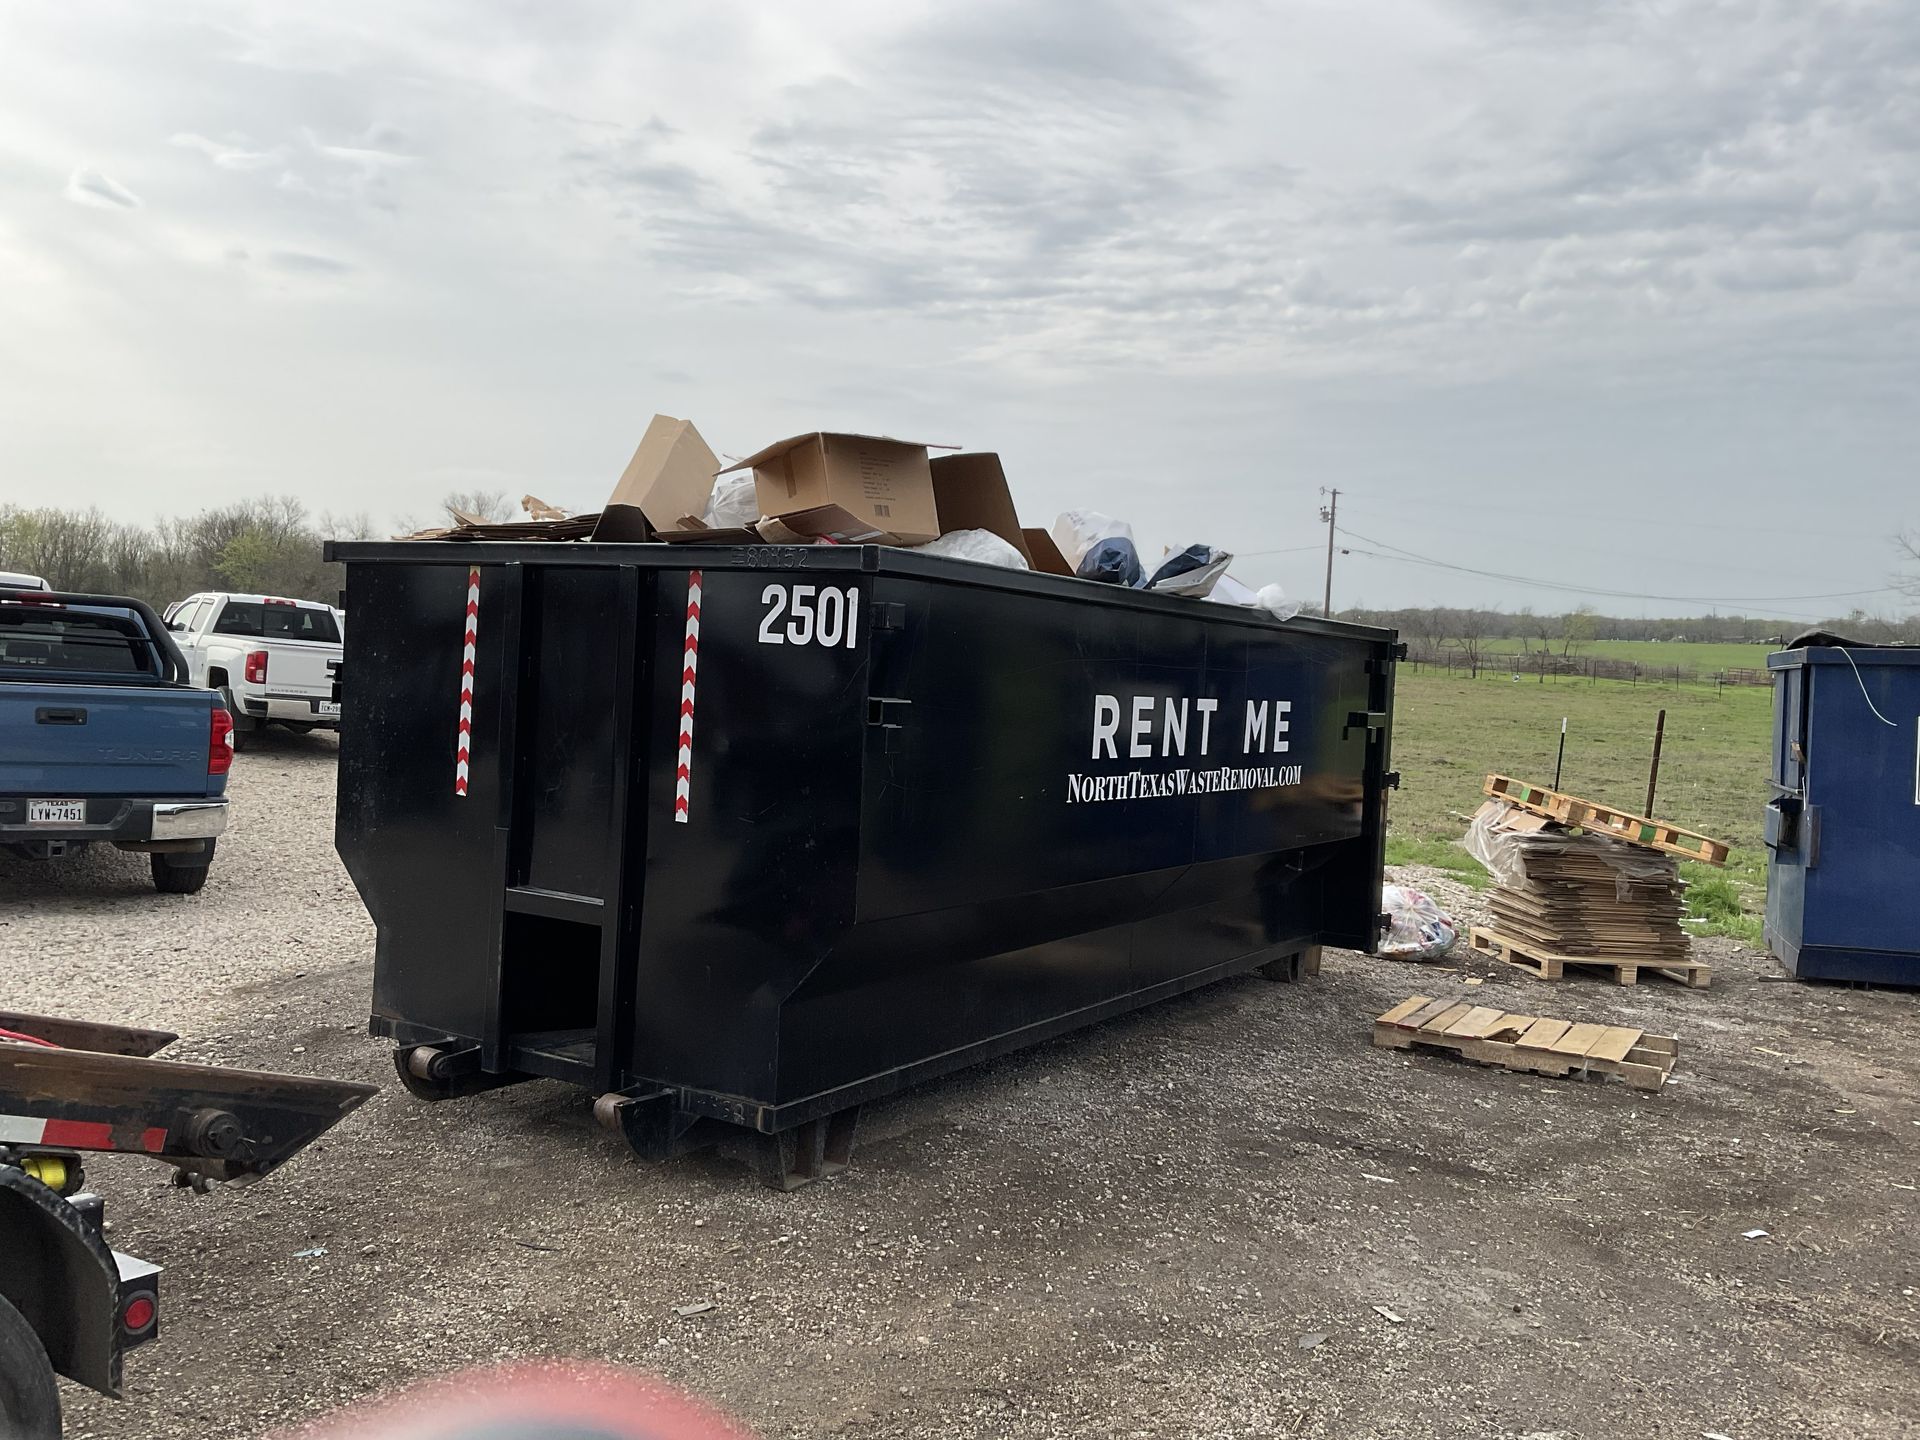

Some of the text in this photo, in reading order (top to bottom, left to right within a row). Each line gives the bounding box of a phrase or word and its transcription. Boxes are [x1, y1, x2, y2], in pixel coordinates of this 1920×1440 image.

[758, 584, 859, 648] 2501
[1091, 694, 1291, 760] RENT ME
